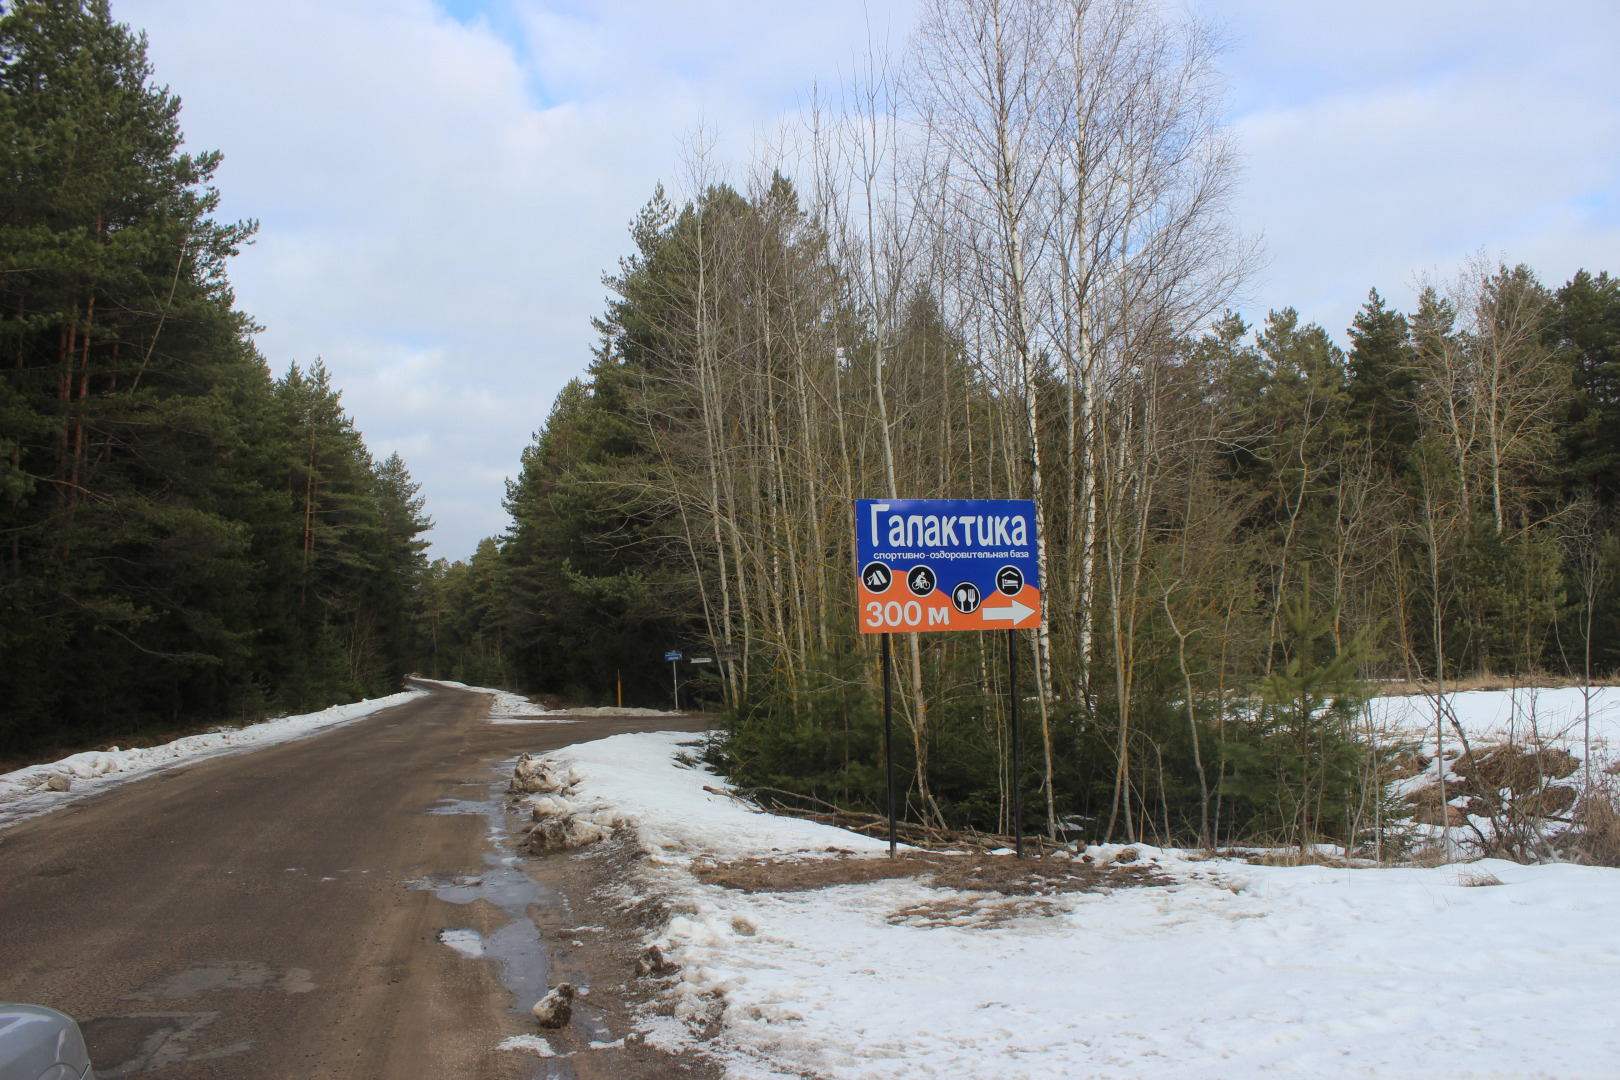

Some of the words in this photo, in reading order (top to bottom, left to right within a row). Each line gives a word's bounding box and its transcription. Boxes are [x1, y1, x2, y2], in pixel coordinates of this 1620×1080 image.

[870, 503, 1028, 548] Галактика
[873, 550, 1009, 562] спортивно-оздоровительная
[1009, 549, 1029, 558] база
[866, 600, 922, 628] 300
[928, 606, 950, 626] м
